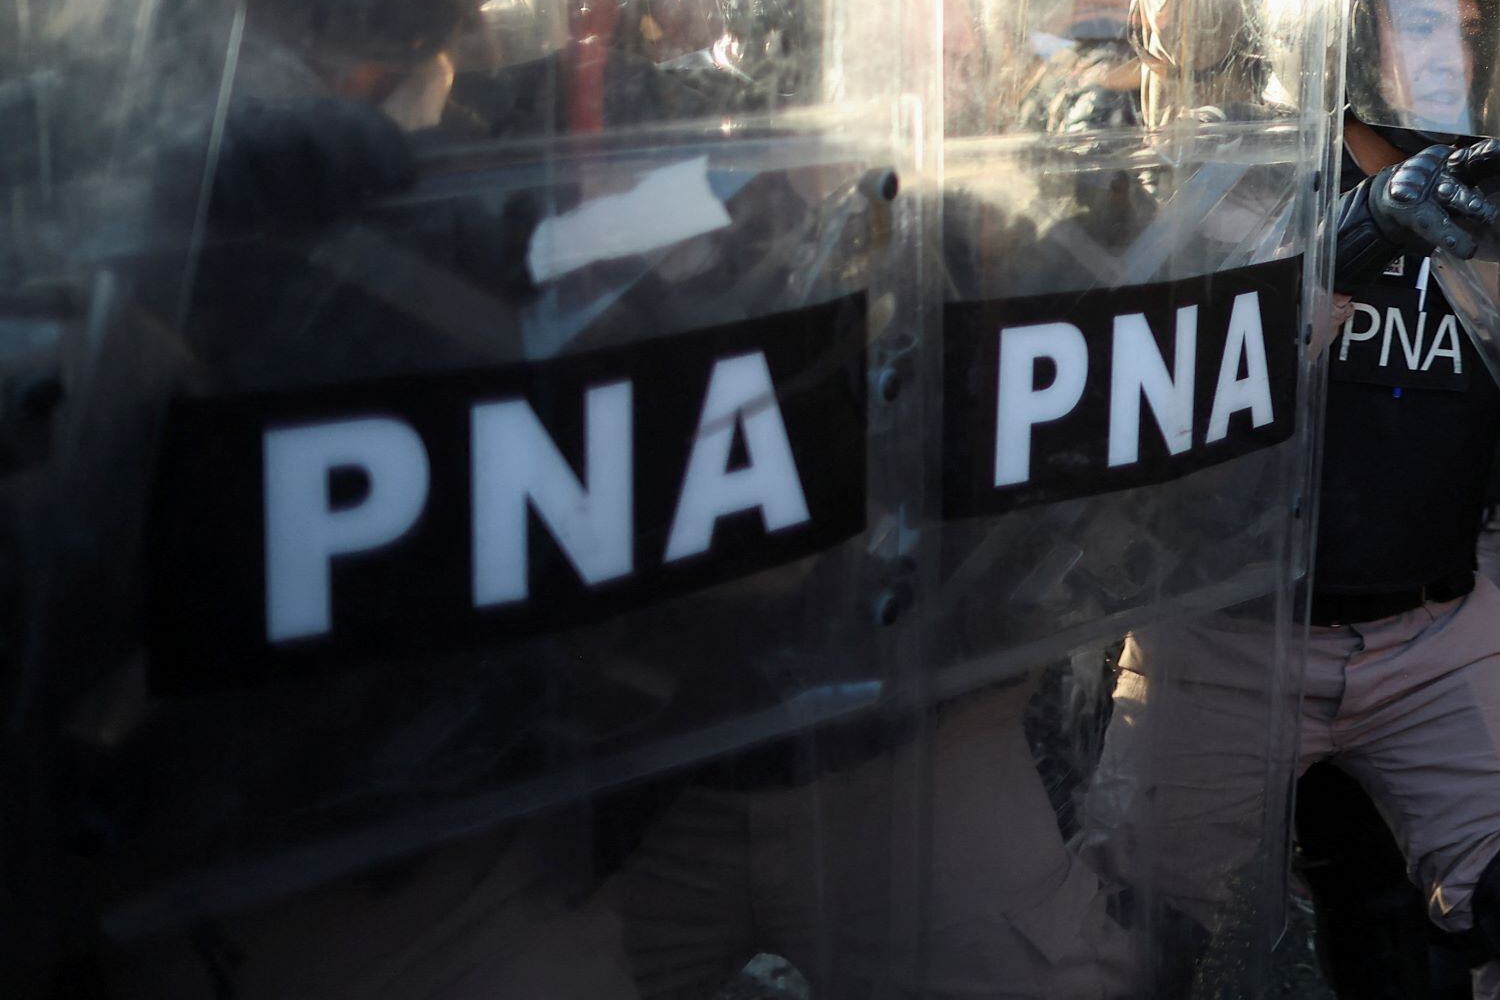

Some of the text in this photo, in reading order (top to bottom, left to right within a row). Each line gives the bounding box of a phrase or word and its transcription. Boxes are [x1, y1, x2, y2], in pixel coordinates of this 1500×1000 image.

[994, 291, 1275, 488] PNA
[1339, 302, 1462, 374] PNA
[262, 350, 811, 645] PNA
